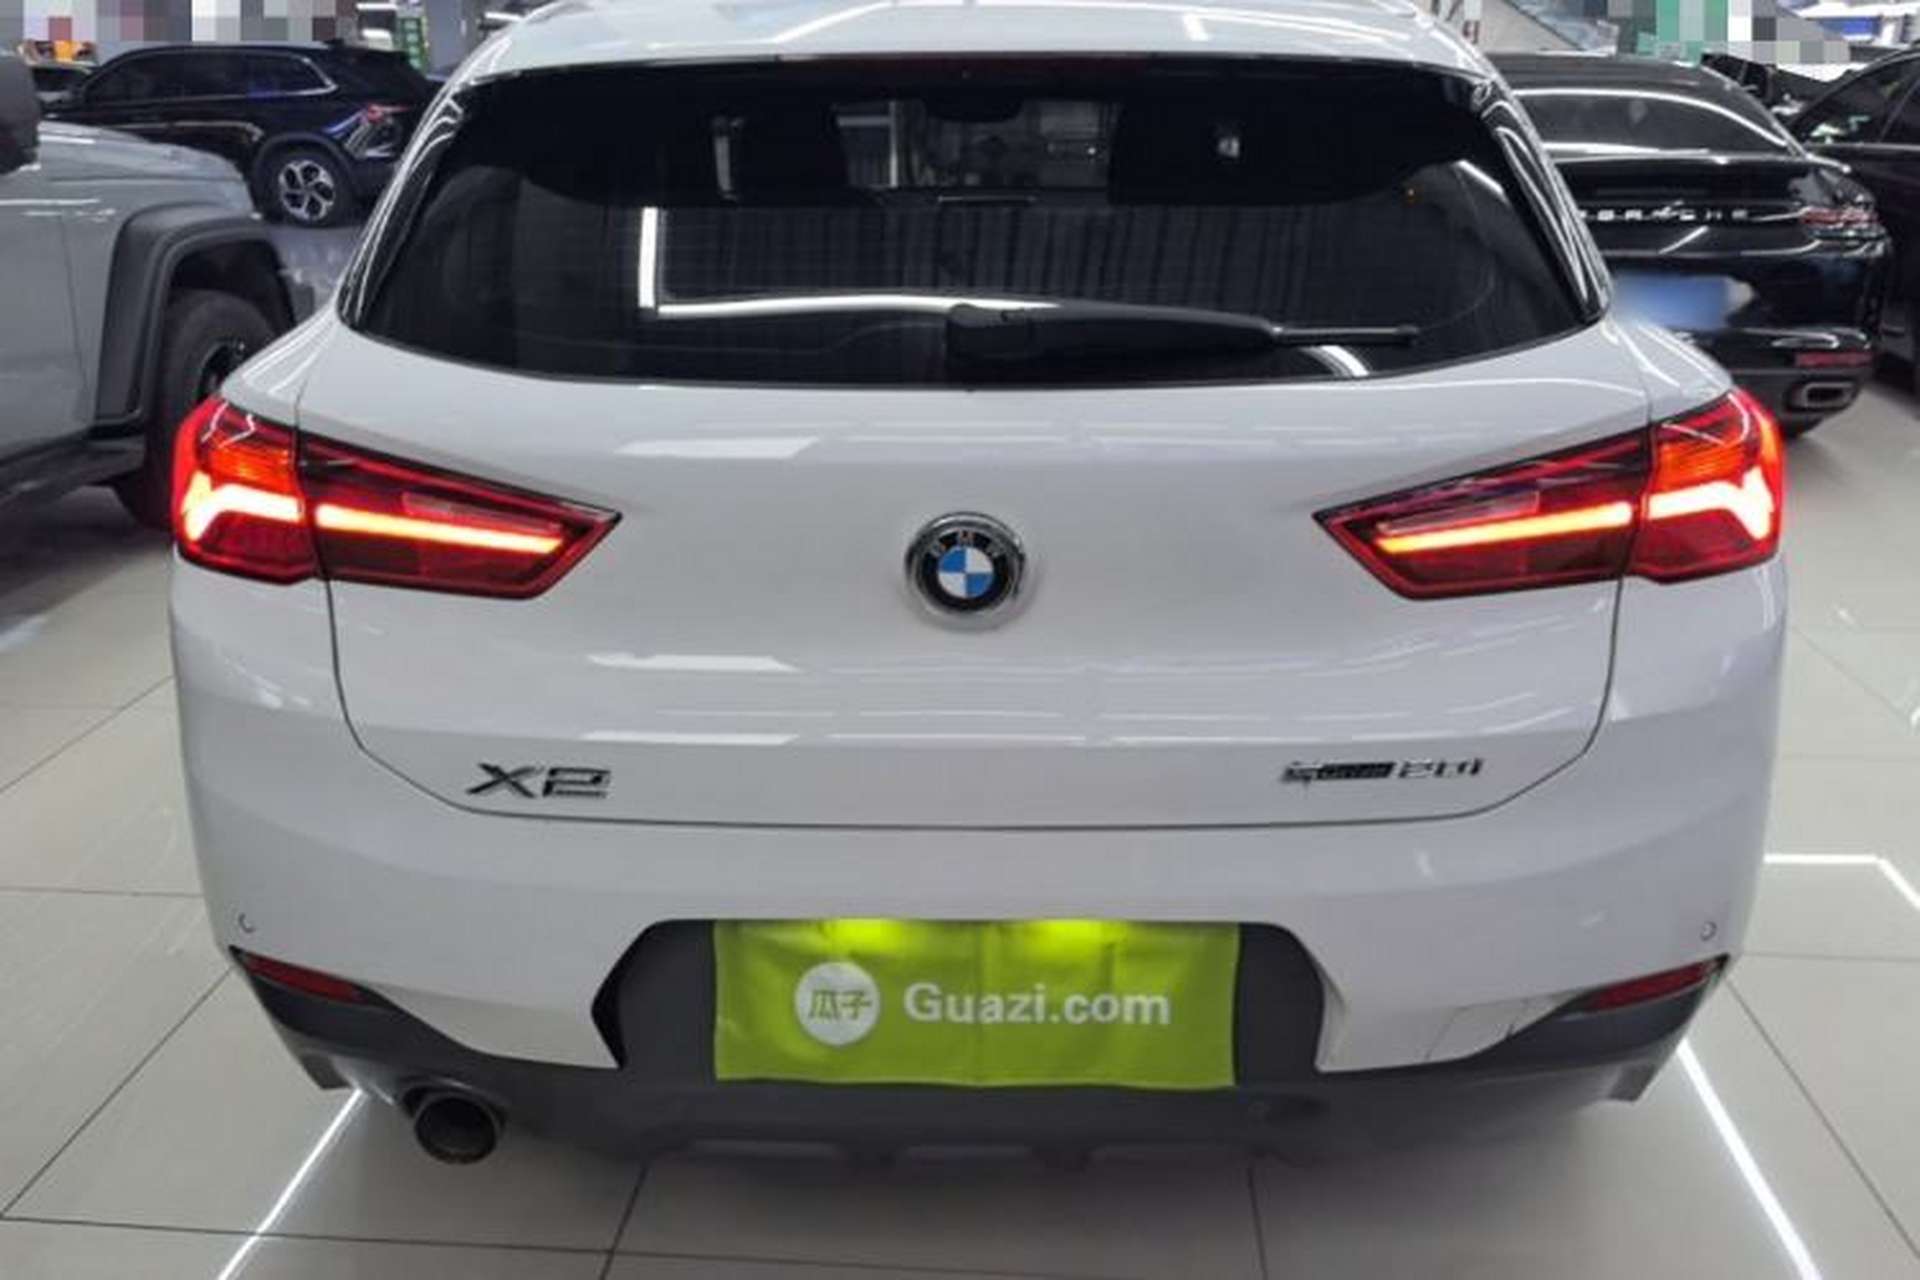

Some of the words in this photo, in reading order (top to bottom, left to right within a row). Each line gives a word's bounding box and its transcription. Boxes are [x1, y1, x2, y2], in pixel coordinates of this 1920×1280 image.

[465, 762, 611, 798] X2
[808, 989, 872, 1020] 瓜子
[903, 982, 1172, 1025] Guazi.com
